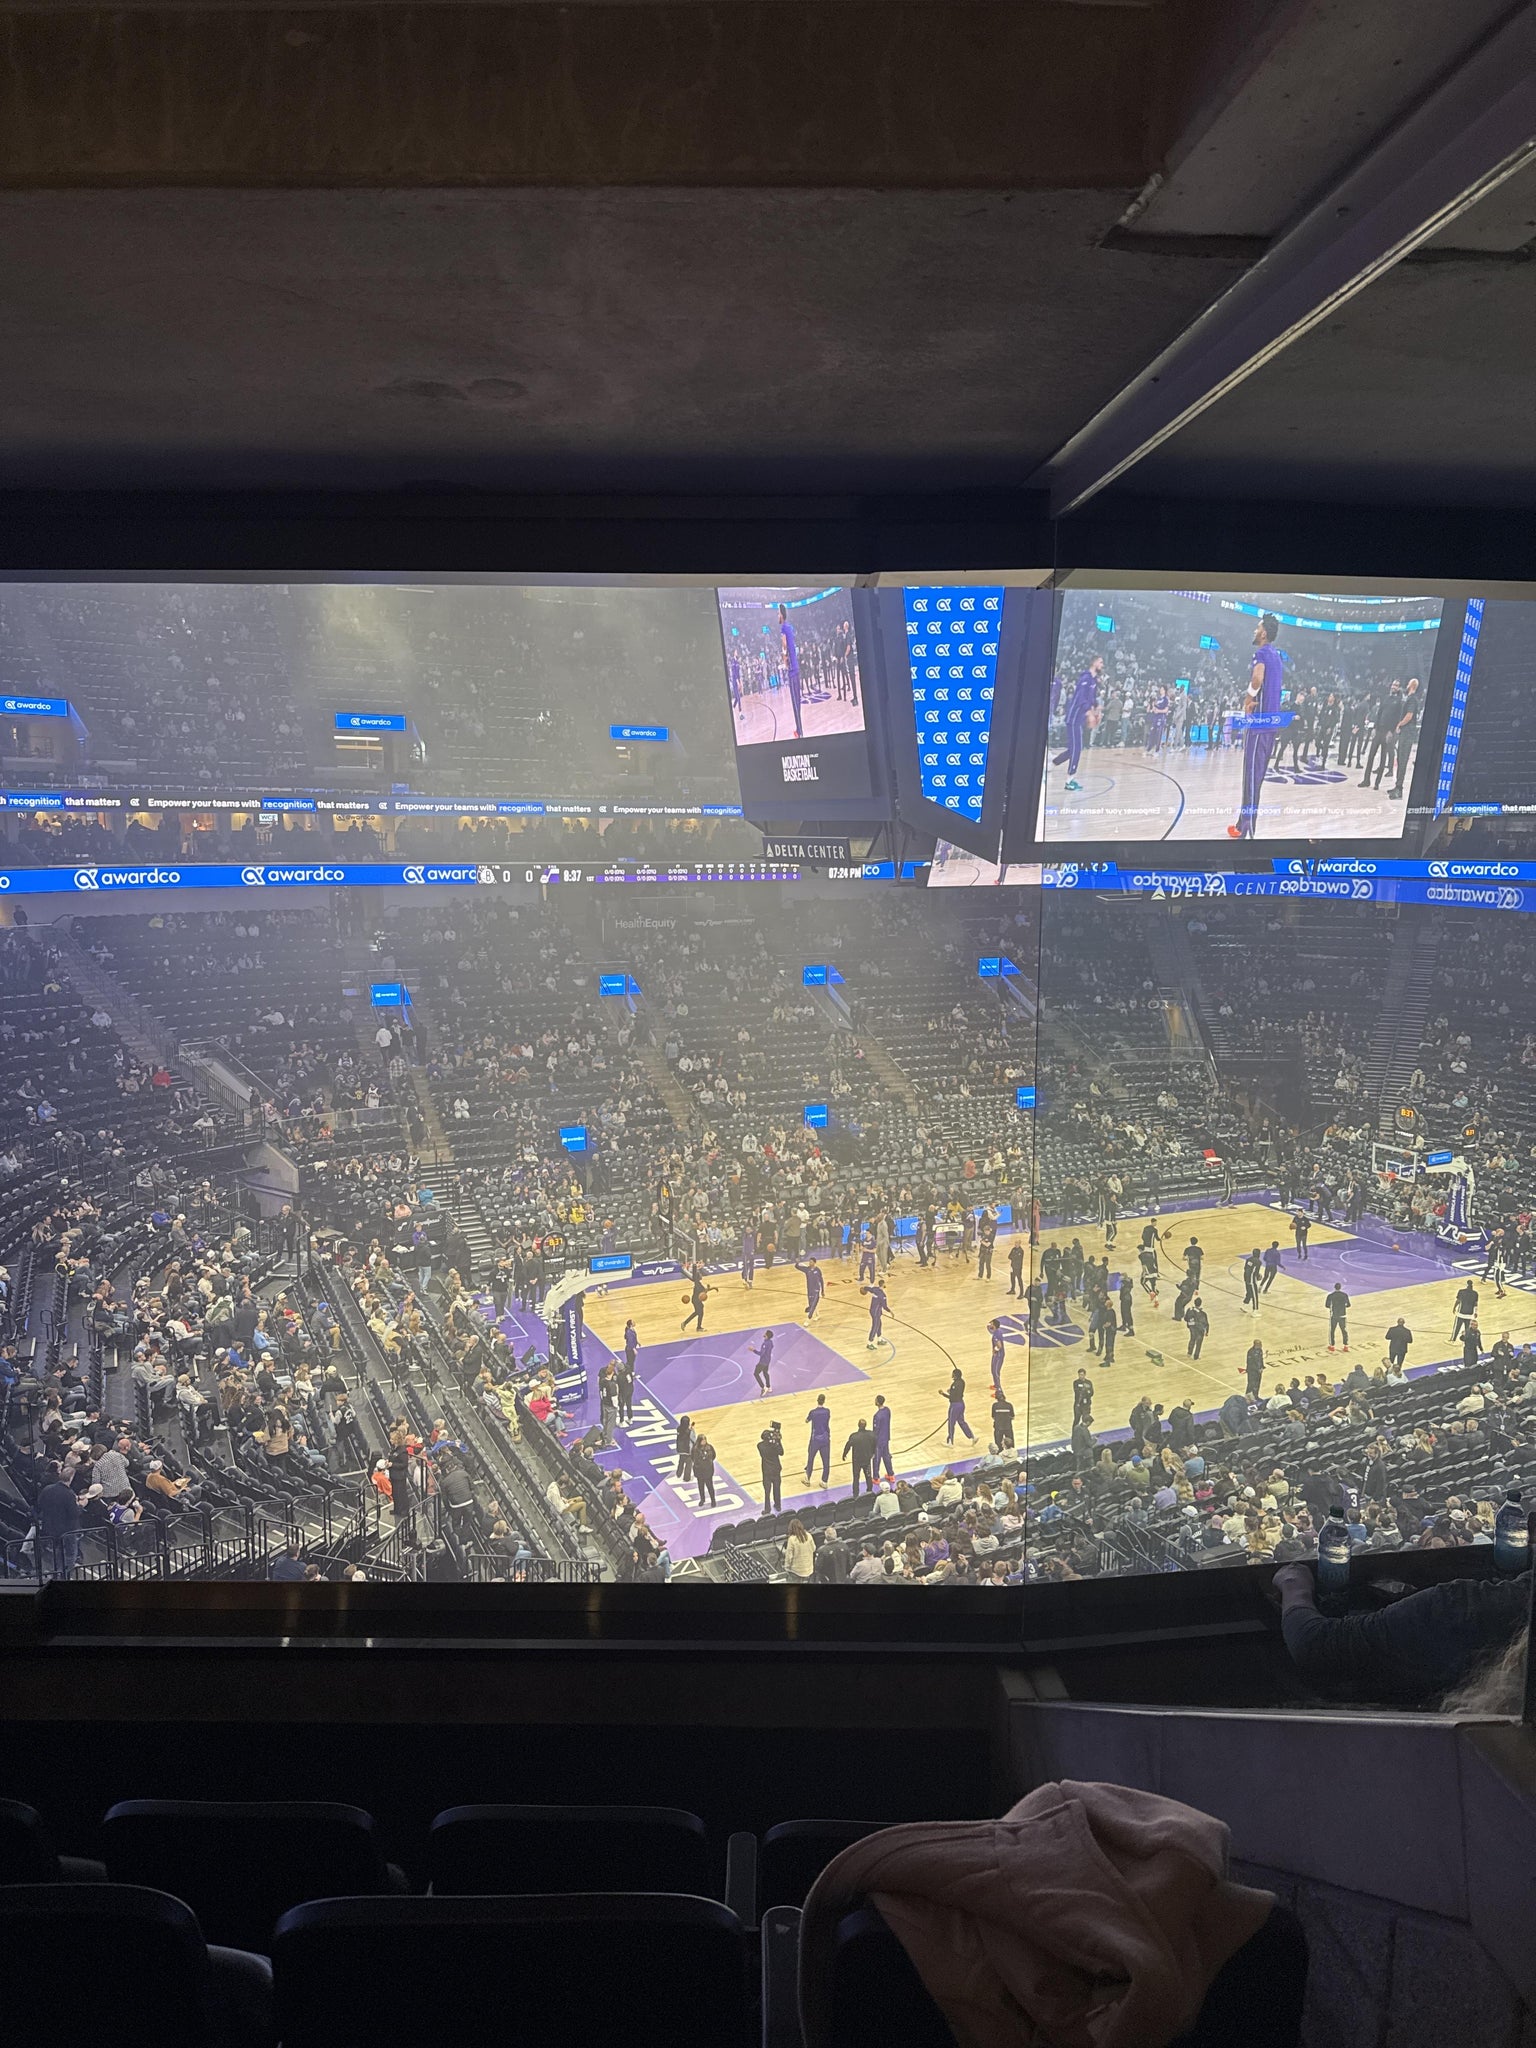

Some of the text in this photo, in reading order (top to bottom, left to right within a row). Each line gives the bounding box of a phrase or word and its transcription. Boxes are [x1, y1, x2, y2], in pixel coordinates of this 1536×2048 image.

[17, 701, 51, 710] awardco
[361, 718, 391, 726] awardco
[631, 729, 657, 737] awardco
[782, 754, 810, 769] MOUNTAIN
[784, 767, 819, 782] BASKETBALL
[9, 796, 61, 808] recognition
[65, 797, 84, 806] that
[86, 798, 121, 807] matters
[148, 798, 369, 810] Empower your teams with recognition that matters
[395, 802, 432, 812] Empower
[433, 804, 453, 812] your
[480, 803, 497, 811] with
[500, 804, 542, 814] recognition
[546, 804, 561, 812] that
[563, 805, 591, 813] matters
[613, 805, 742, 815] Empower your teams with recognition
[1454, 804, 1498, 814] recognition
[1502, 804, 1518, 812] that
[774, 844, 846, 860] DELTA CENTER
[267, 866, 345, 882] awardco
[563, 869, 582, 882] 8:37
[828, 867, 862, 879] 07:24 PM
[1450, 862, 1519, 876] awardco
[101, 867, 181, 885] awardco
[502, 870, 533, 883] 0 0
[1170, 883, 1228, 898] DELTA
[615, 918, 676, 930] HealthEquity
[570, 1329, 579, 1360] AMERICA
[1265, 1354, 1315, 1369] ELTA
[1350, 1494, 1358, 1508] 3
[1027, 1563, 1036, 1574] 3
